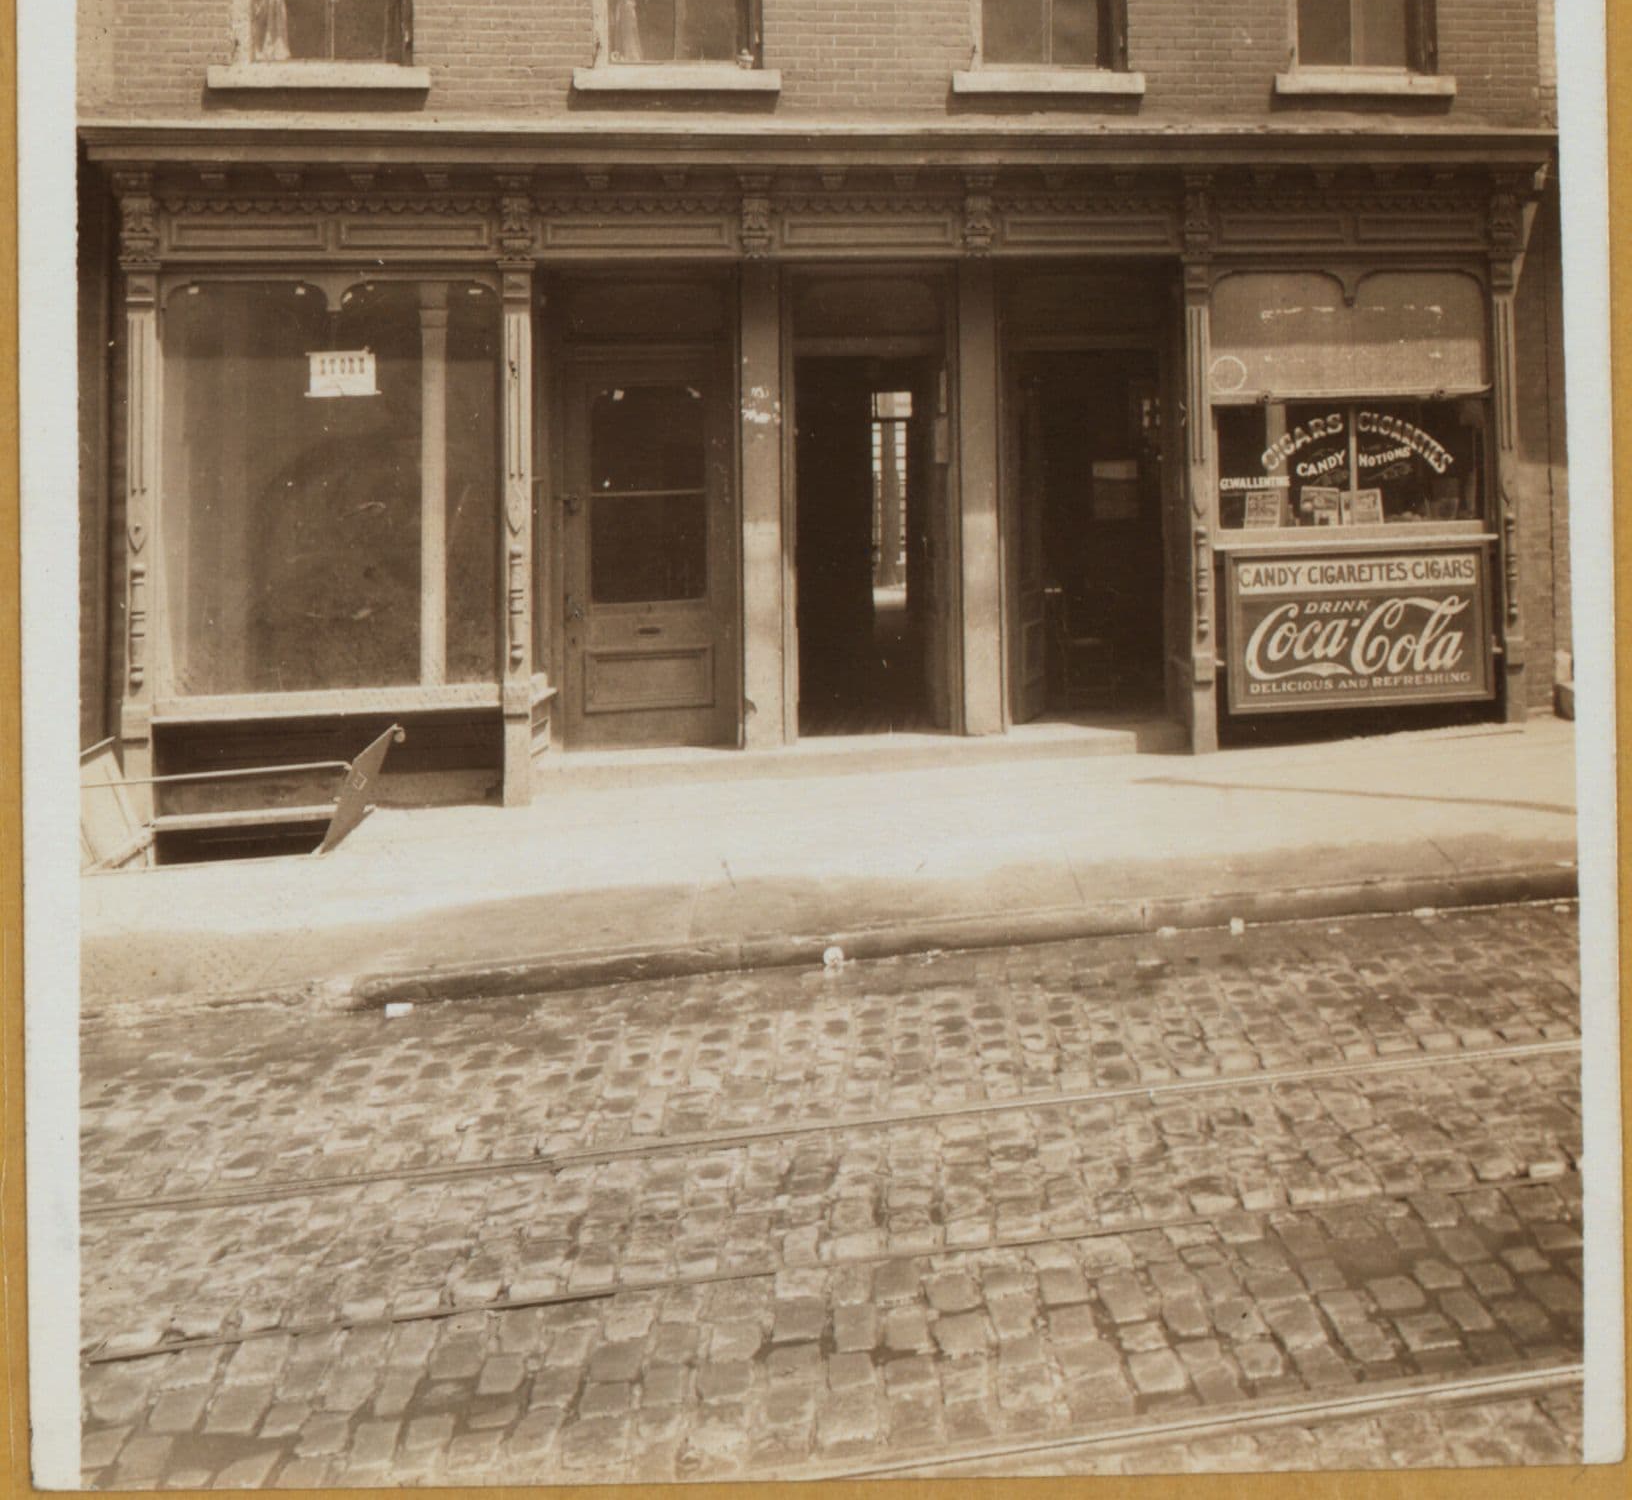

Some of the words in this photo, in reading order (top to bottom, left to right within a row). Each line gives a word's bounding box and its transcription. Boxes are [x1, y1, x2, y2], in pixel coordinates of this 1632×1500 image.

[1261, 413, 1344, 470] CIGARS
[1296, 450, 1346, 477] CANDY
[1239, 566, 1303, 587] CANDY
[1308, 561, 1408, 585] CIGARETTES
[1411, 559, 1474, 579] CIGARS
[1304, 600, 1371, 615] DRINK
[1250, 678, 1334, 695] DELICIOUS
[1338, 676, 1369, 690] AND
[1372, 671, 1471, 688] REFRESHING
